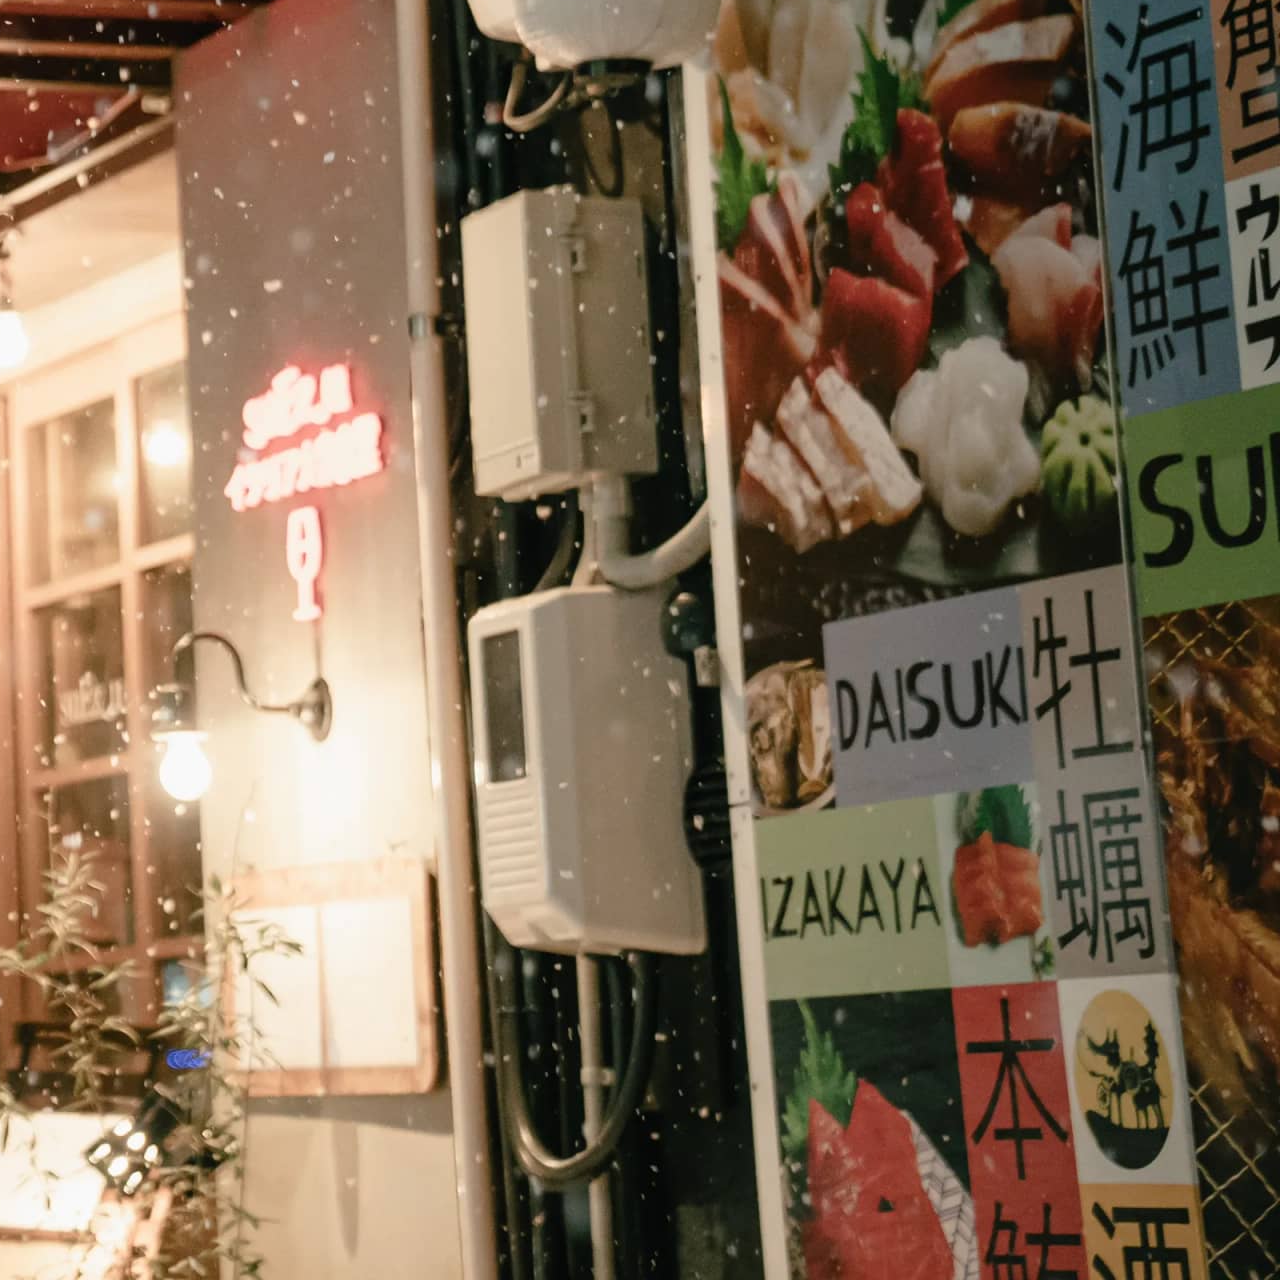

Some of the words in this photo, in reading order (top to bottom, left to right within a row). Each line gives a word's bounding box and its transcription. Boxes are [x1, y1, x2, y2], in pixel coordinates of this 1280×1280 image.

[1103, 4, 1230, 388] 海鮮
[835, 644, 1029, 752] DAISUKI
[1032, 589, 1156, 964] 牡蠣
[760, 856, 942, 943] IZAKAYA
